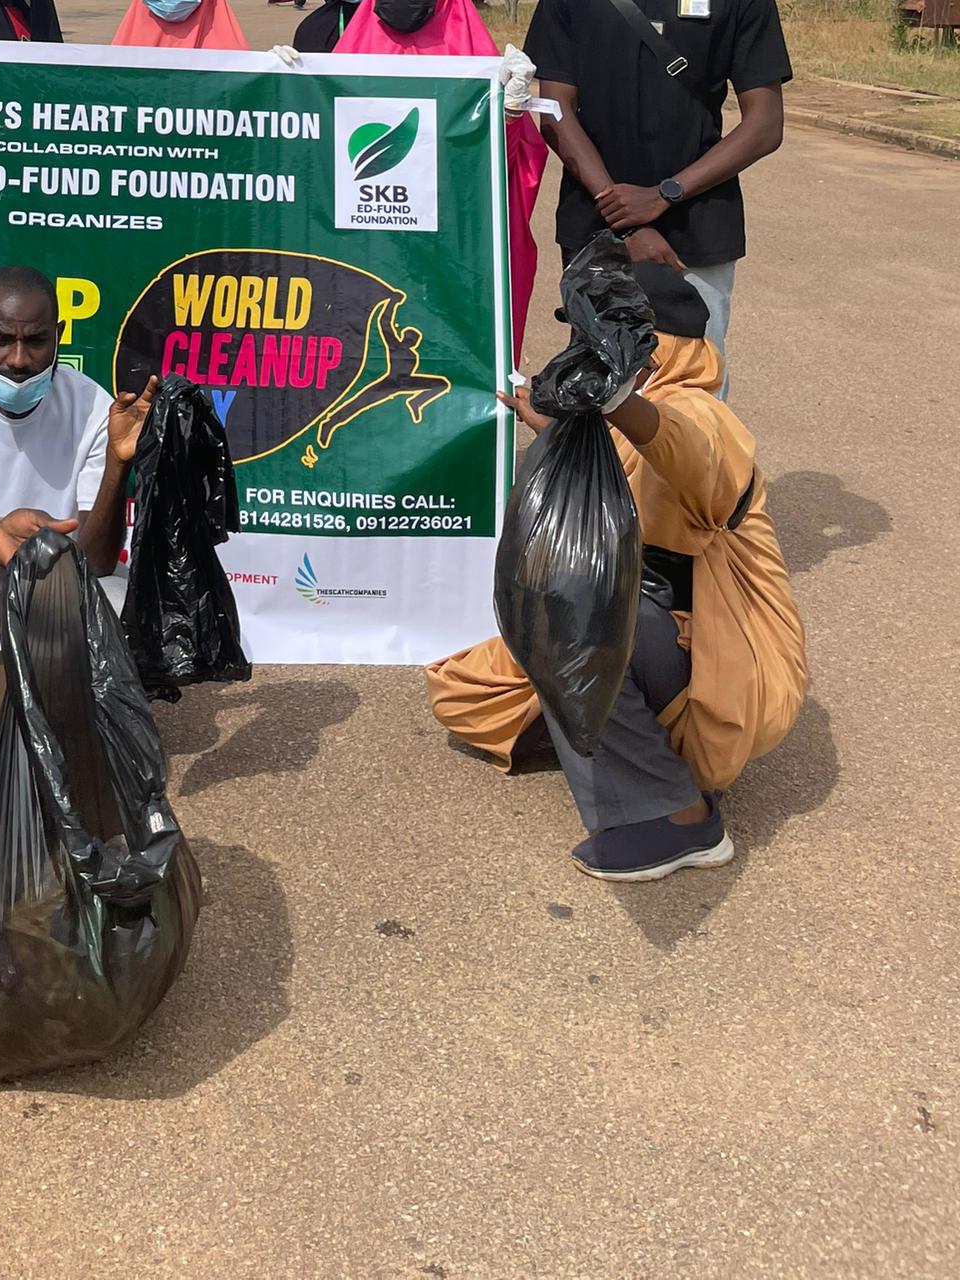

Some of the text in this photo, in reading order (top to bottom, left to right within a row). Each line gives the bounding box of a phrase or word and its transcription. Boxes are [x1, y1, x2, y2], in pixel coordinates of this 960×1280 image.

[33, 102, 128, 132] HEART
[137, 106, 321, 140] FOUNDATION
[167, 146, 219, 160] WITH
[111, 168, 296, 203] FOUNDATION
[359, 184, 409, 203] SKB
[357, 204, 411, 214] ED-FUND
[8, 210, 163, 230] ORGANIZES
[350, 215, 418, 226] FOUNDATION
[173, 273, 313, 330] WORLD
[161, 330, 343, 390] CLEANUP
[246, 487, 456, 510] FOR ENQUIRIES CALL:
[239, 510, 472, 532] 8144281526, 09122736021
[225, 572, 279, 585] OPMENT
[316, 588, 387, 596] THESCATHCOMPANIES
